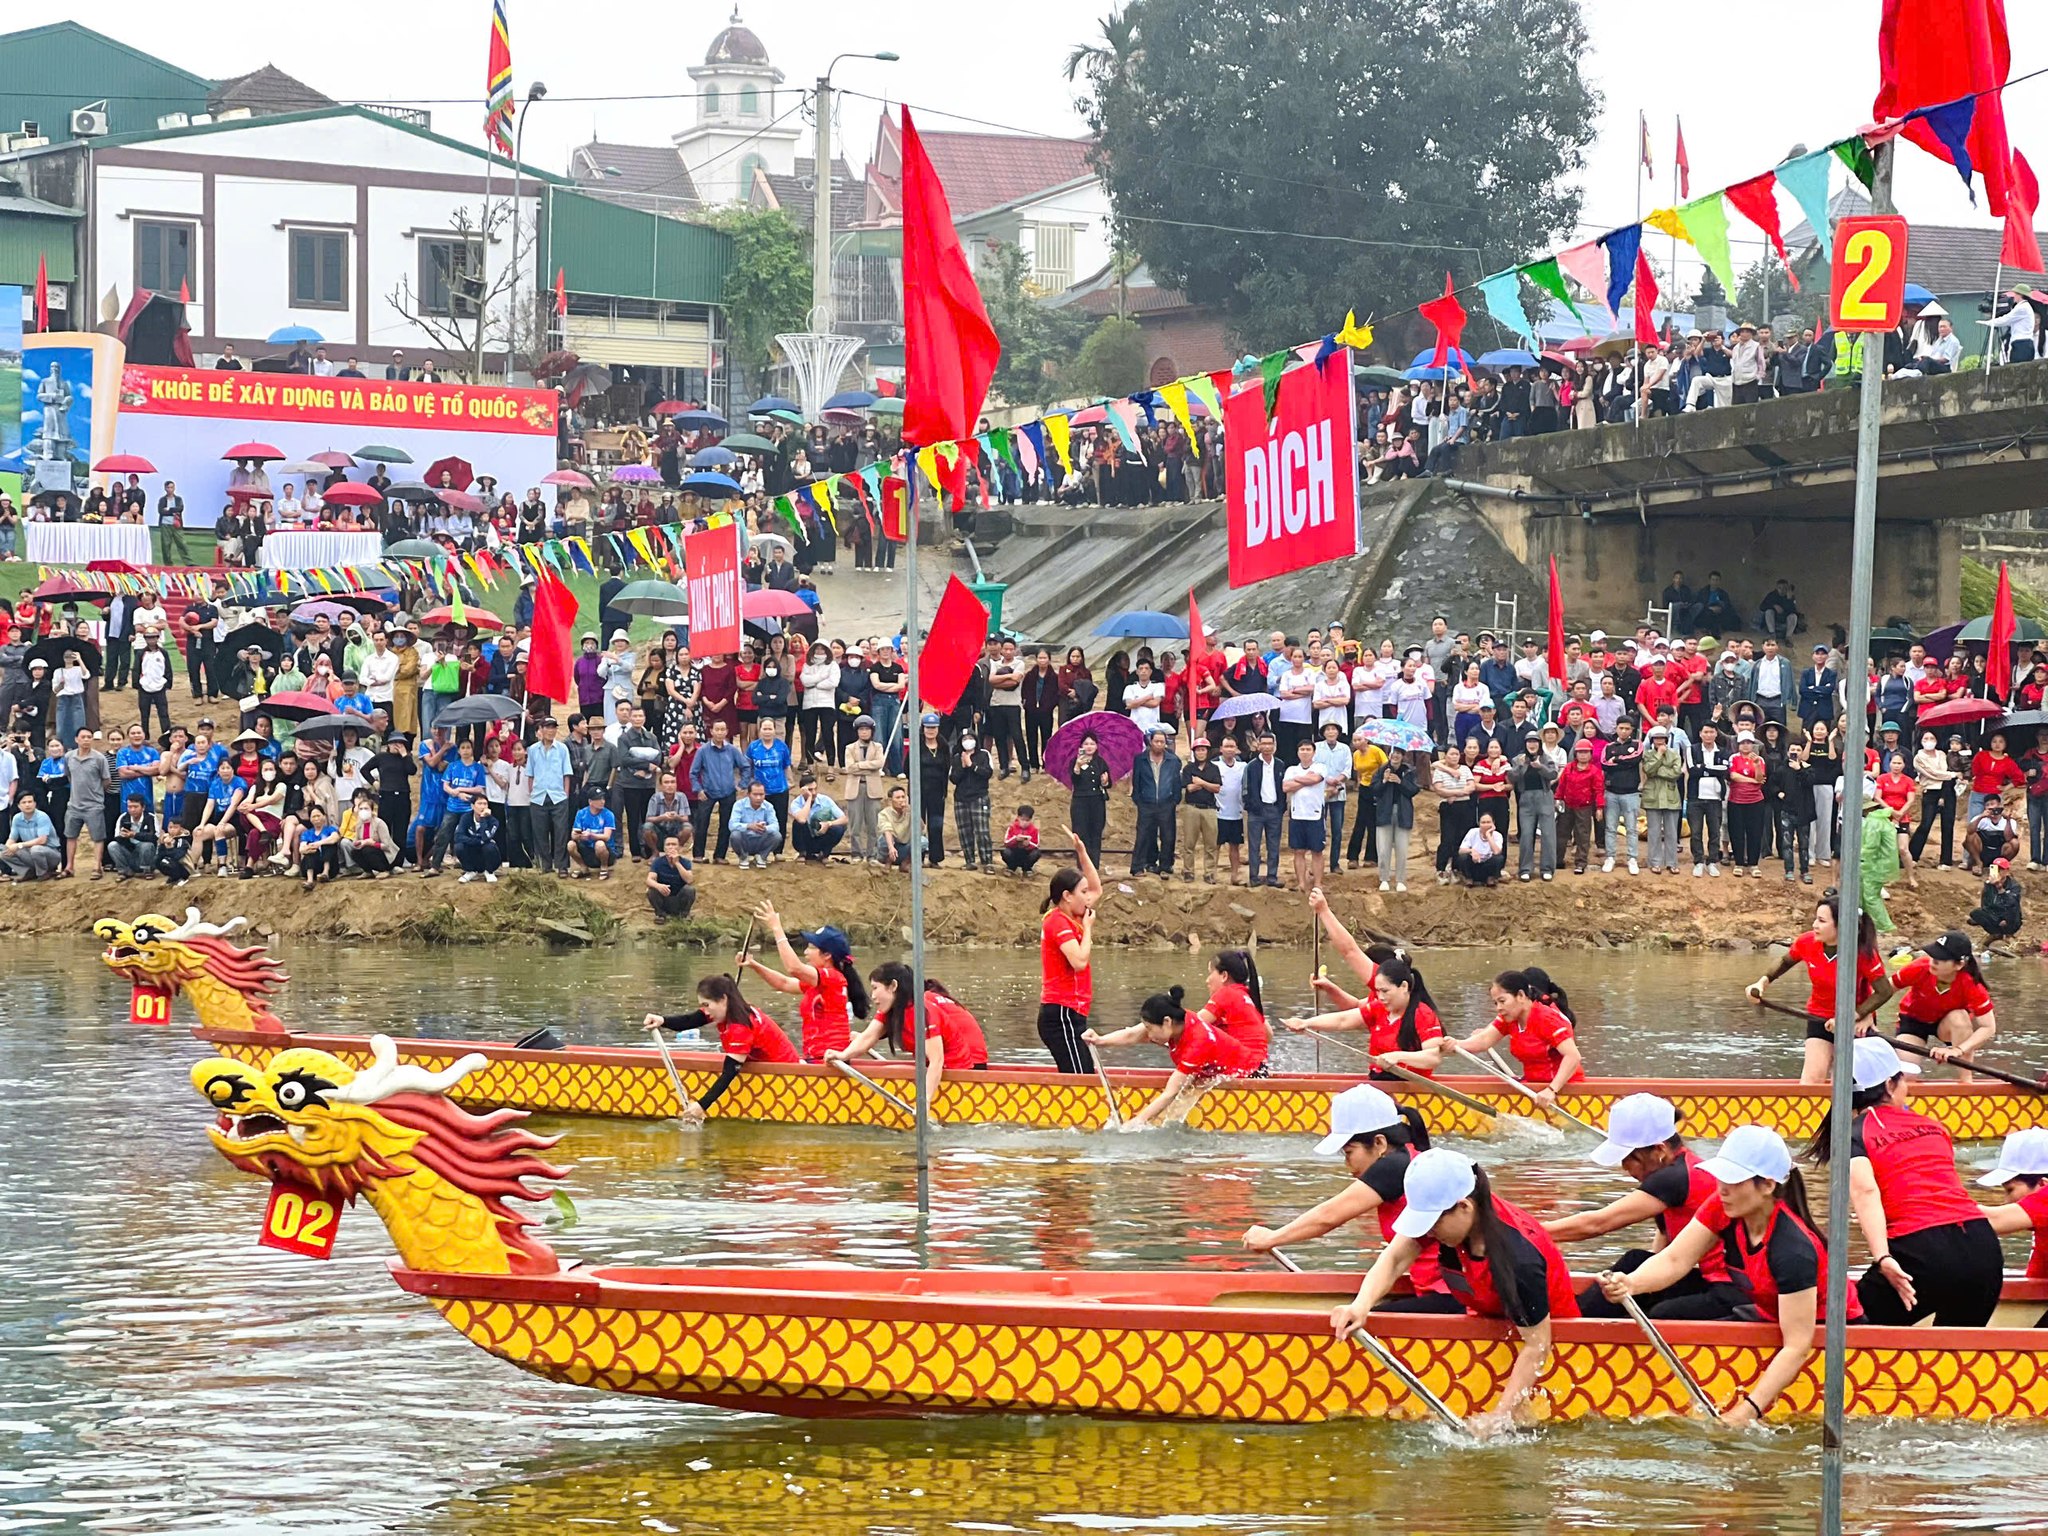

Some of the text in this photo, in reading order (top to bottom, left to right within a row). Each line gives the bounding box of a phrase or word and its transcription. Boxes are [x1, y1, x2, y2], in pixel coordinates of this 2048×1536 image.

[1840, 230, 1892, 321] 2
[152, 374, 518, 420] KHỎE ĐỂ XÂY DỰNG VÀ BẢO VỆ TỔ QUỐC
[1244, 416, 1334, 548] ĐÍCH
[893, 487, 907, 536] 1
[689, 556, 735, 634] XUẤT PHÁT
[136, 994, 166, 1020] 01
[270, 1192, 334, 1248] 02
